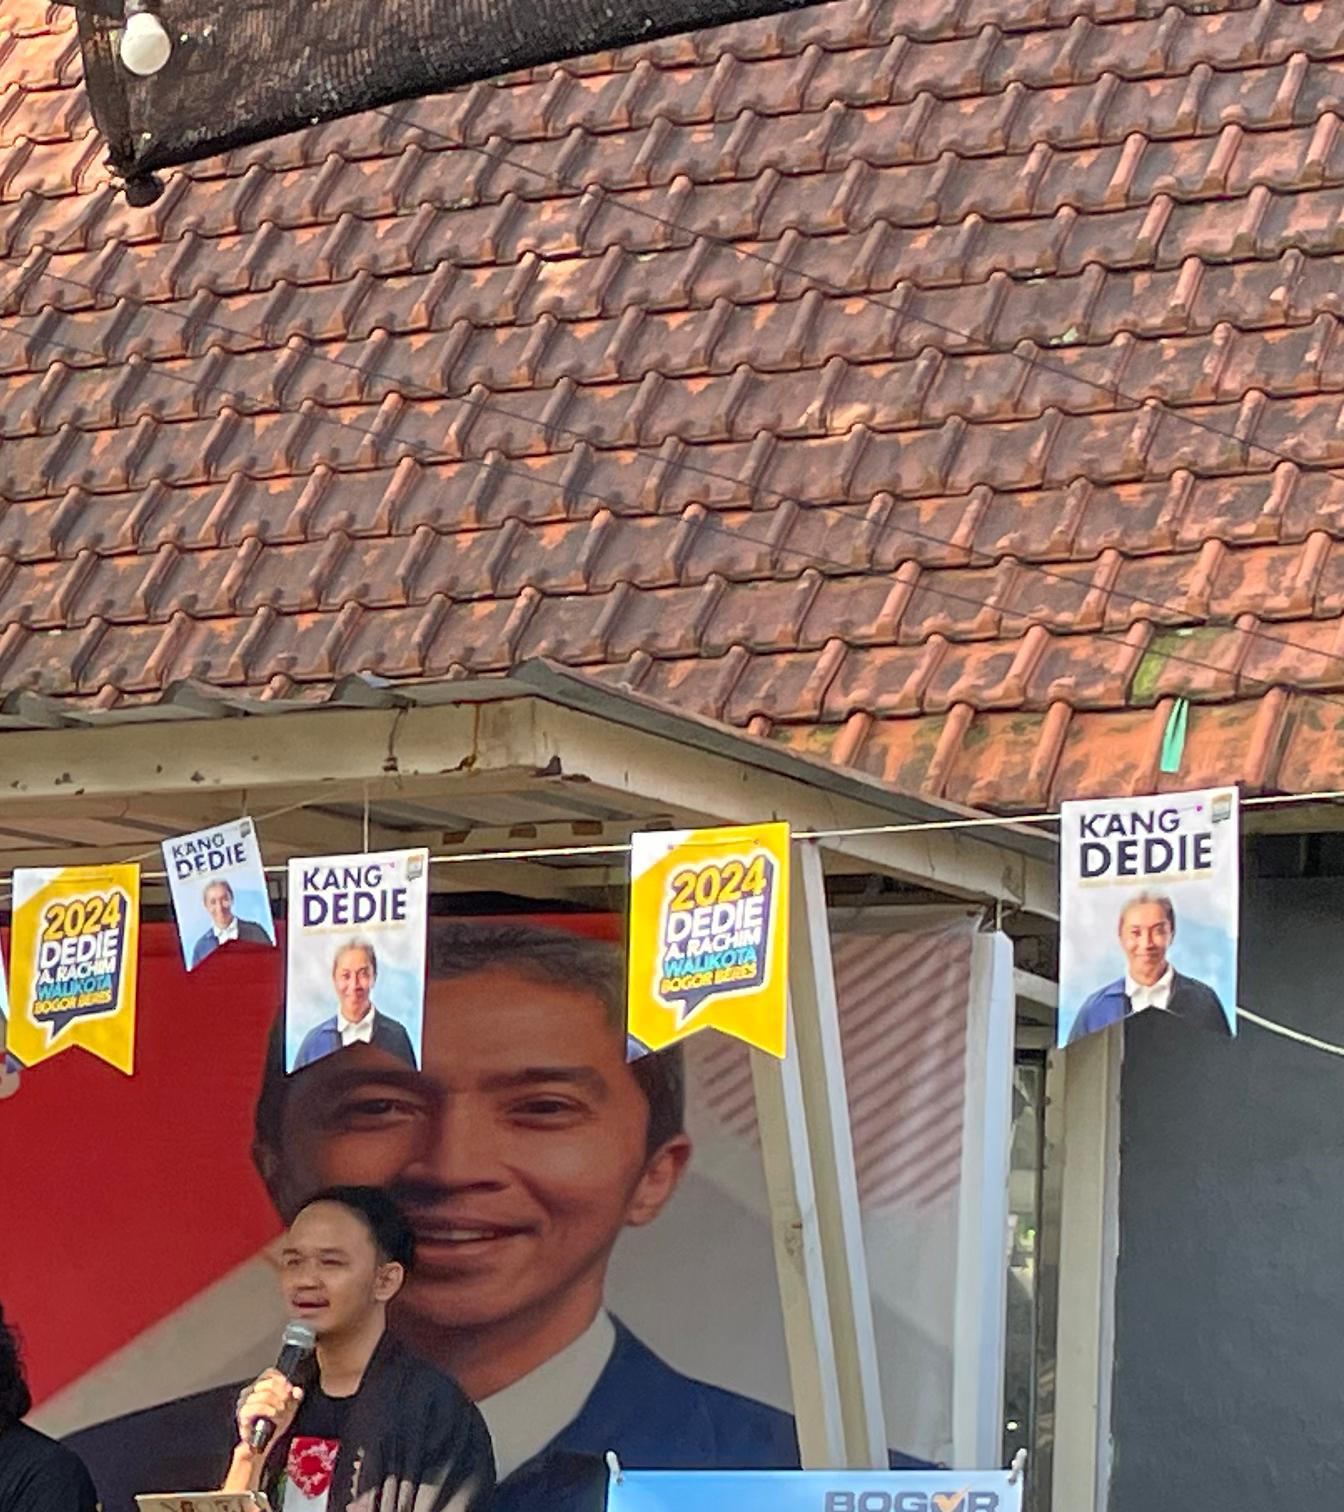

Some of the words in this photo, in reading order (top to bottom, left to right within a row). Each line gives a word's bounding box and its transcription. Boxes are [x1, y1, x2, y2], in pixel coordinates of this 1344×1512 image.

[1079, 808, 1181, 839] KANG
[171, 832, 226, 859] KANG
[174, 842, 248, 880] DEDIE
[1079, 832, 1212, 878] DEDIE
[303, 863, 383, 891] KANG
[670, 855, 768, 912] 2024
[43, 891, 121, 941] 2024
[302, 887, 407, 927] DEDIE
[666, 894, 766, 944] DEDIE
[40, 928, 120, 970] DEDIE
[686, 926, 762, 957] RACHIM
[664, 946, 758, 978] WALIKOTA
